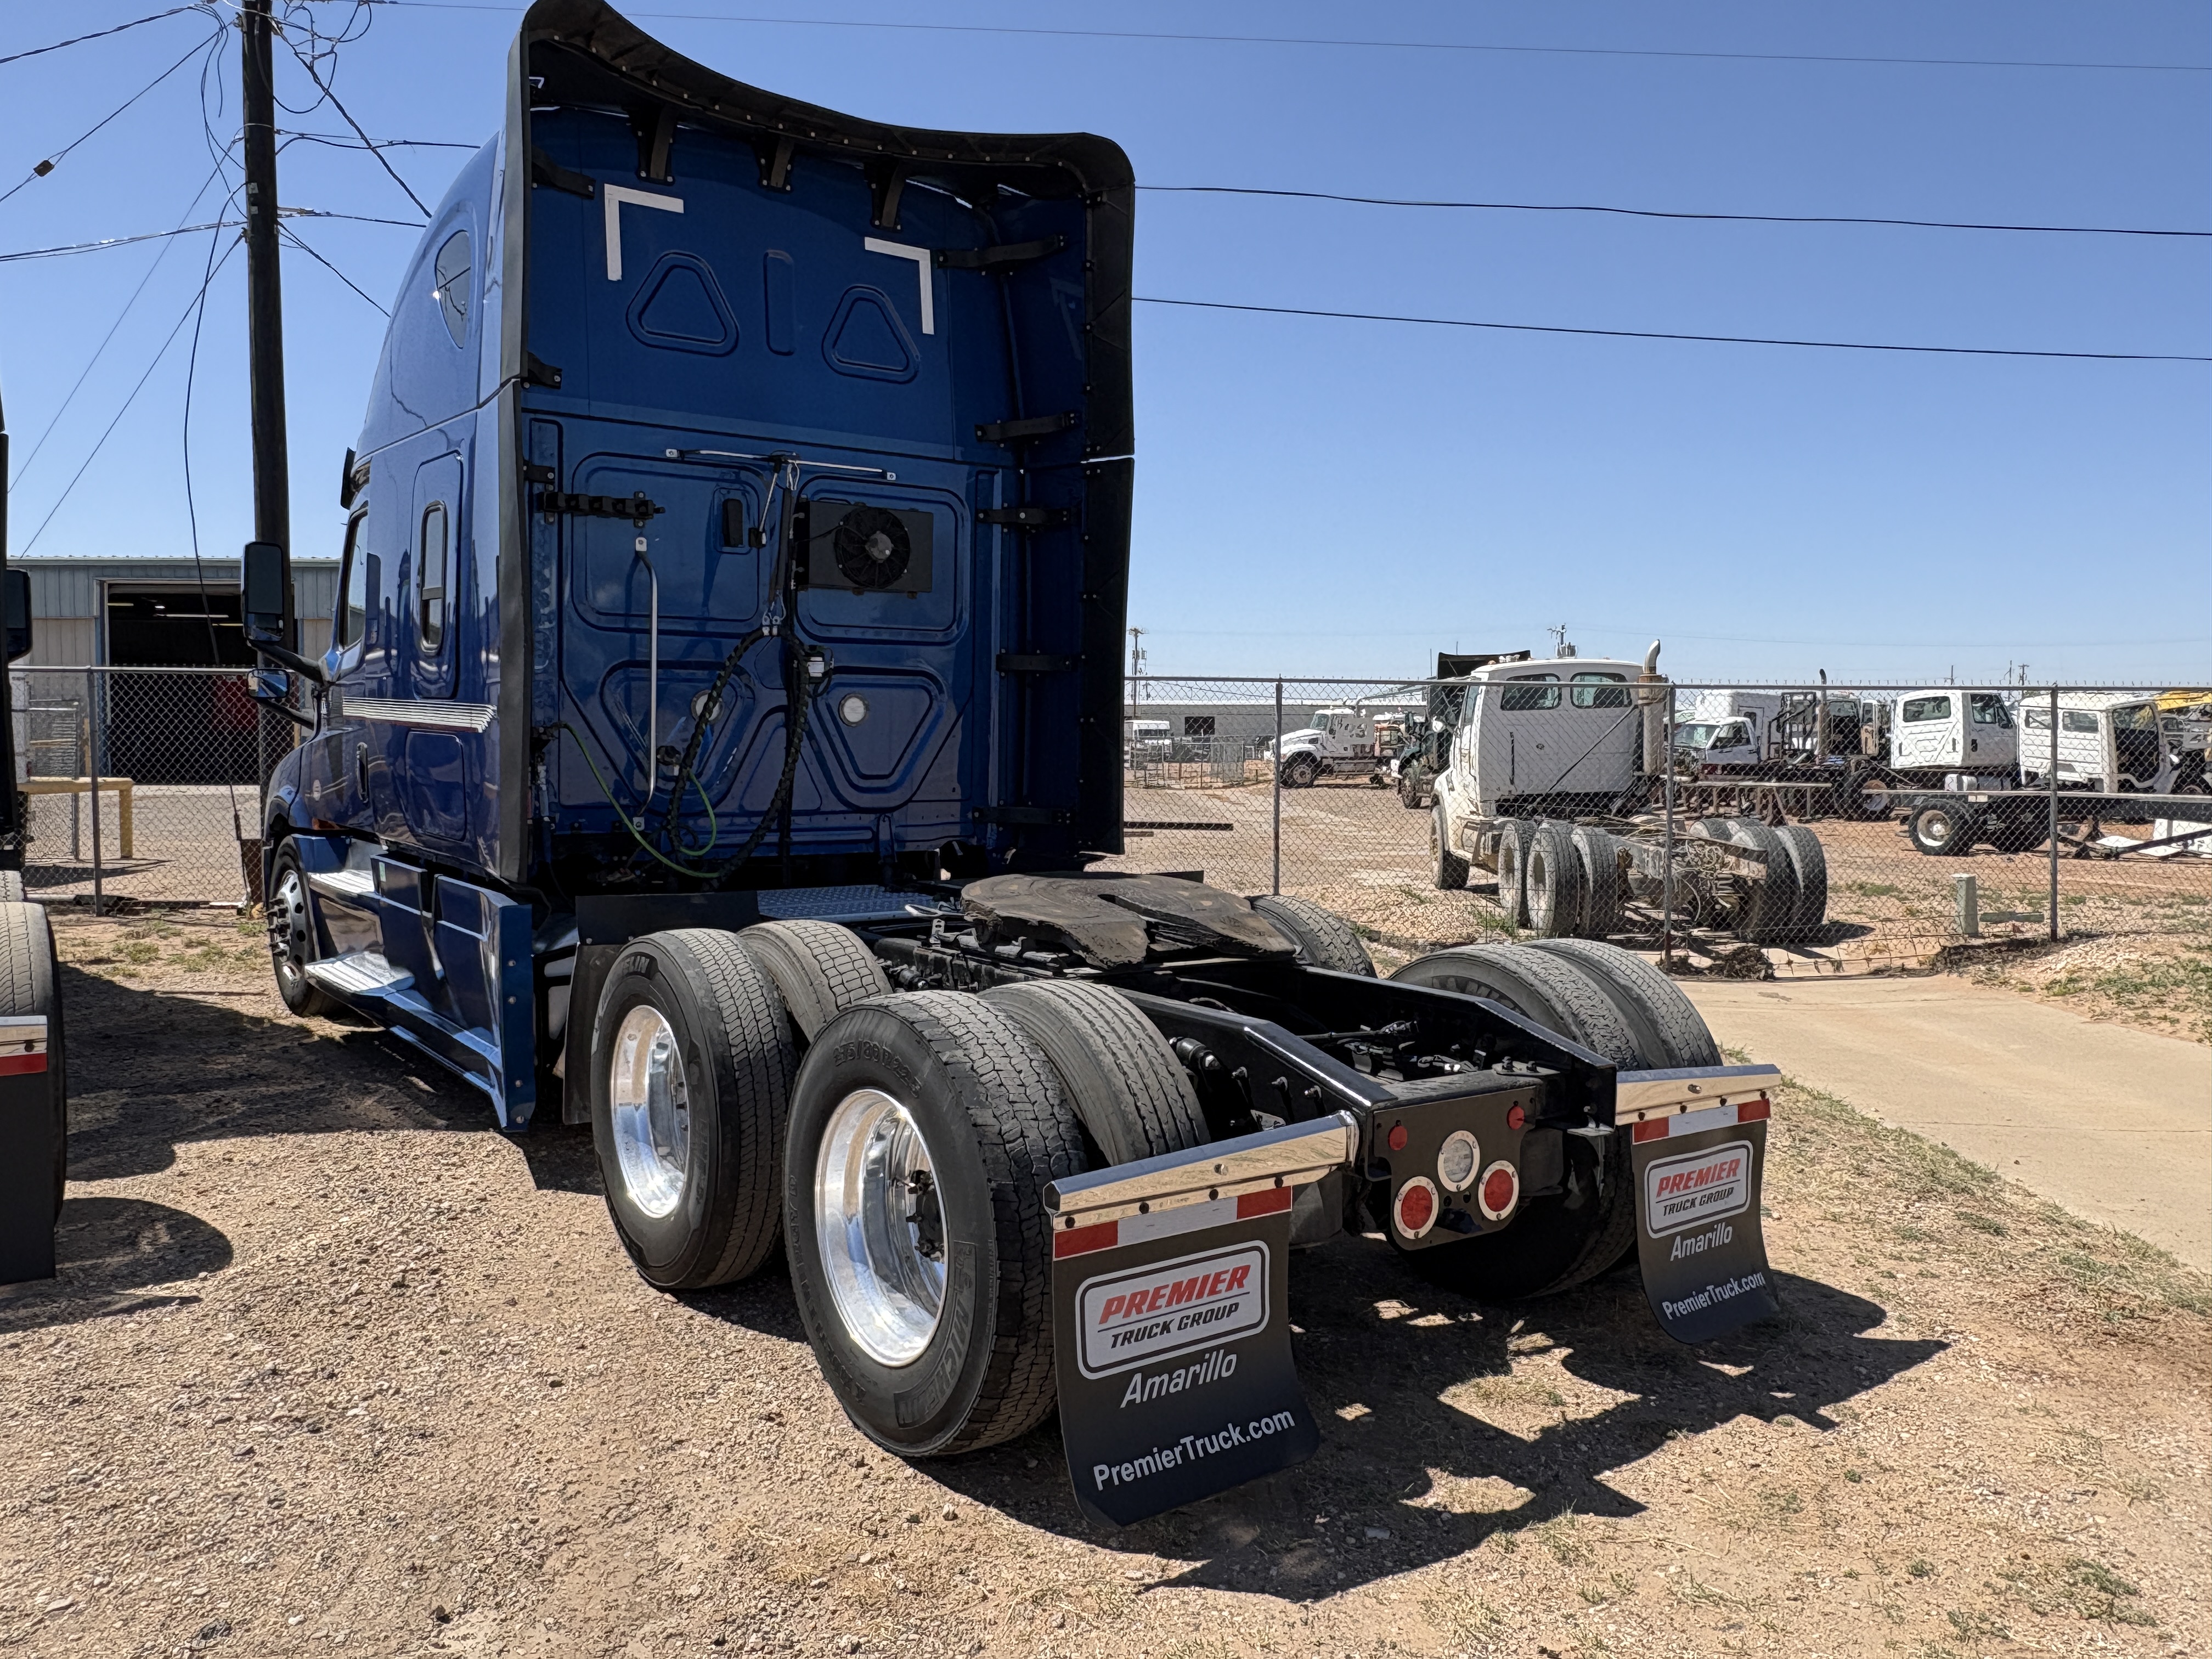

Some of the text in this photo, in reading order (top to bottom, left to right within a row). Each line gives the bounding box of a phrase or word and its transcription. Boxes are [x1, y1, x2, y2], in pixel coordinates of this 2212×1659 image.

[1656, 1158, 1741, 1198] PREMIER
[1663, 1187, 1734, 1216] TRUCK GROUP
[1670, 1222, 1733, 1261] Amarillo
[1098, 1265, 1251, 1325] PREMIER
[1662, 1271, 1766, 1321] PremierTruck.com
[1110, 1302, 1239, 1348] TRUCK GROUP
[1120, 1349, 1237, 1409] Amarillo
[1093, 1411, 1295, 1491] PremierTruck.com
